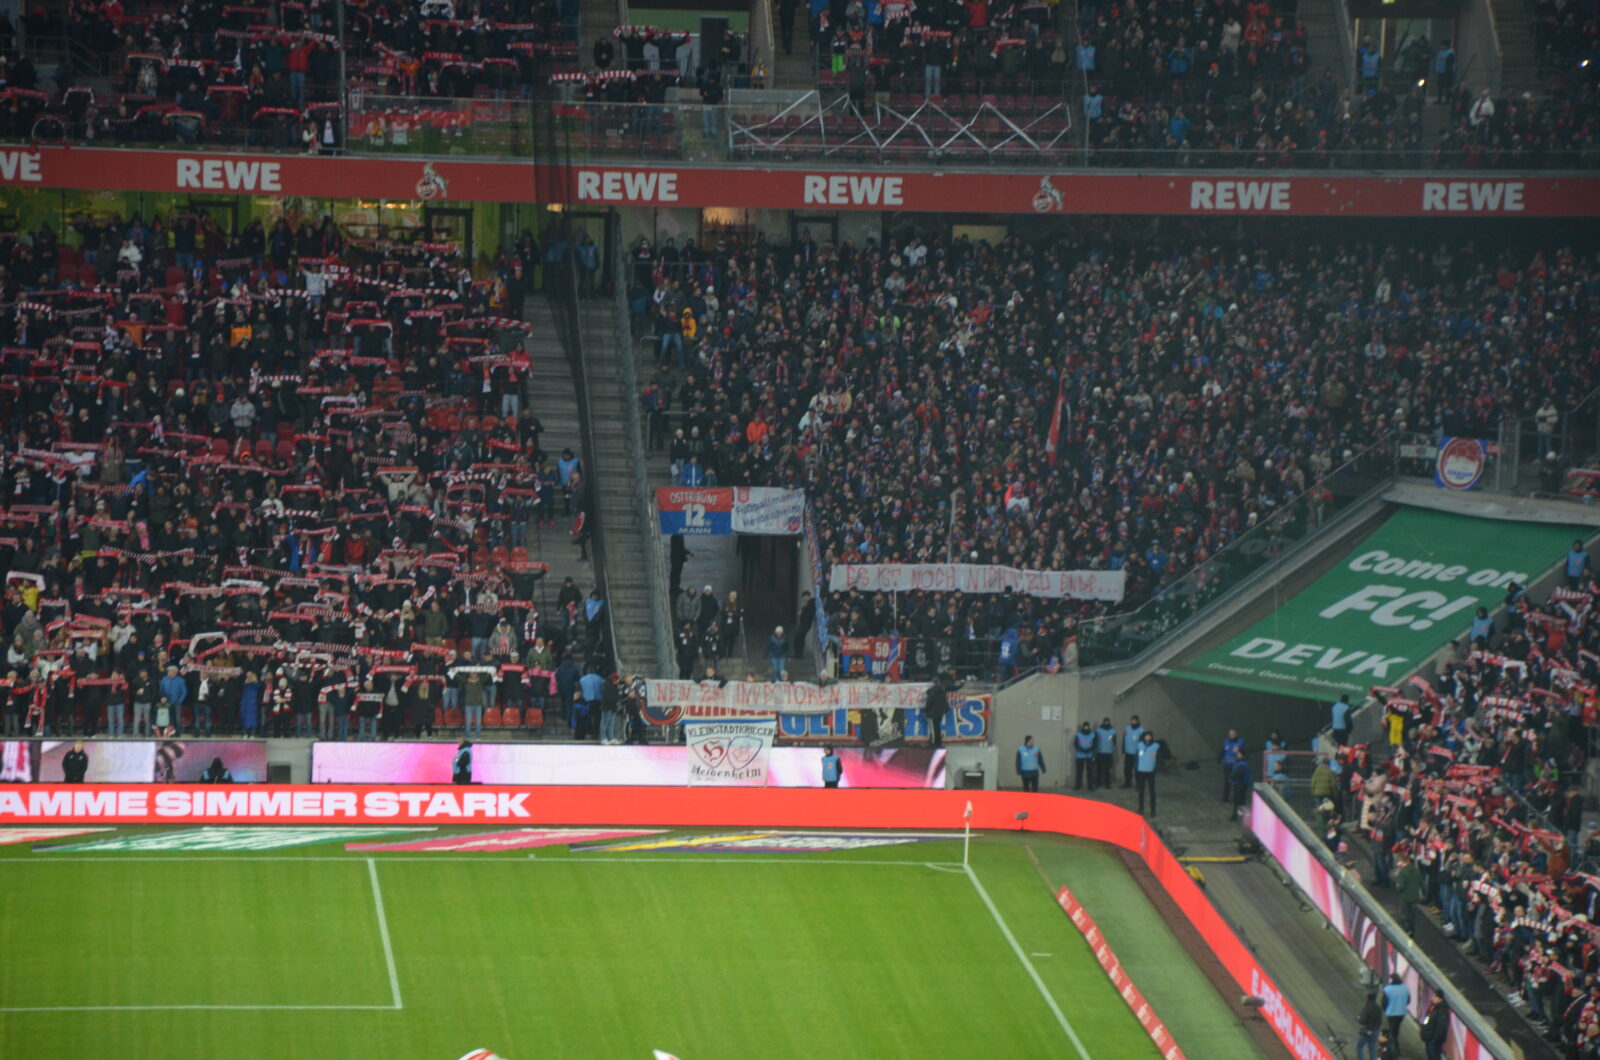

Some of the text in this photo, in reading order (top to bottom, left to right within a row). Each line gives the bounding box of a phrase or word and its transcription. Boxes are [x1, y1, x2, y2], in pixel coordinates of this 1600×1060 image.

[177, 158, 282, 191] REWE
[577, 170, 678, 202] REWE
[803, 175, 905, 206] REWE
[1190, 180, 1291, 211] REWE
[1422, 182, 1525, 211] REWE
[846, 564, 869, 587] ES
[911, 566, 957, 590] NOCH
[1025, 572, 1051, 592] ZU
[1348, 550, 1528, 590] Come on
[1318, 584, 1479, 631] FC!
[1230, 637, 1408, 679] DEVK
[0, 790, 532, 819] AMME SIMMER STARK
